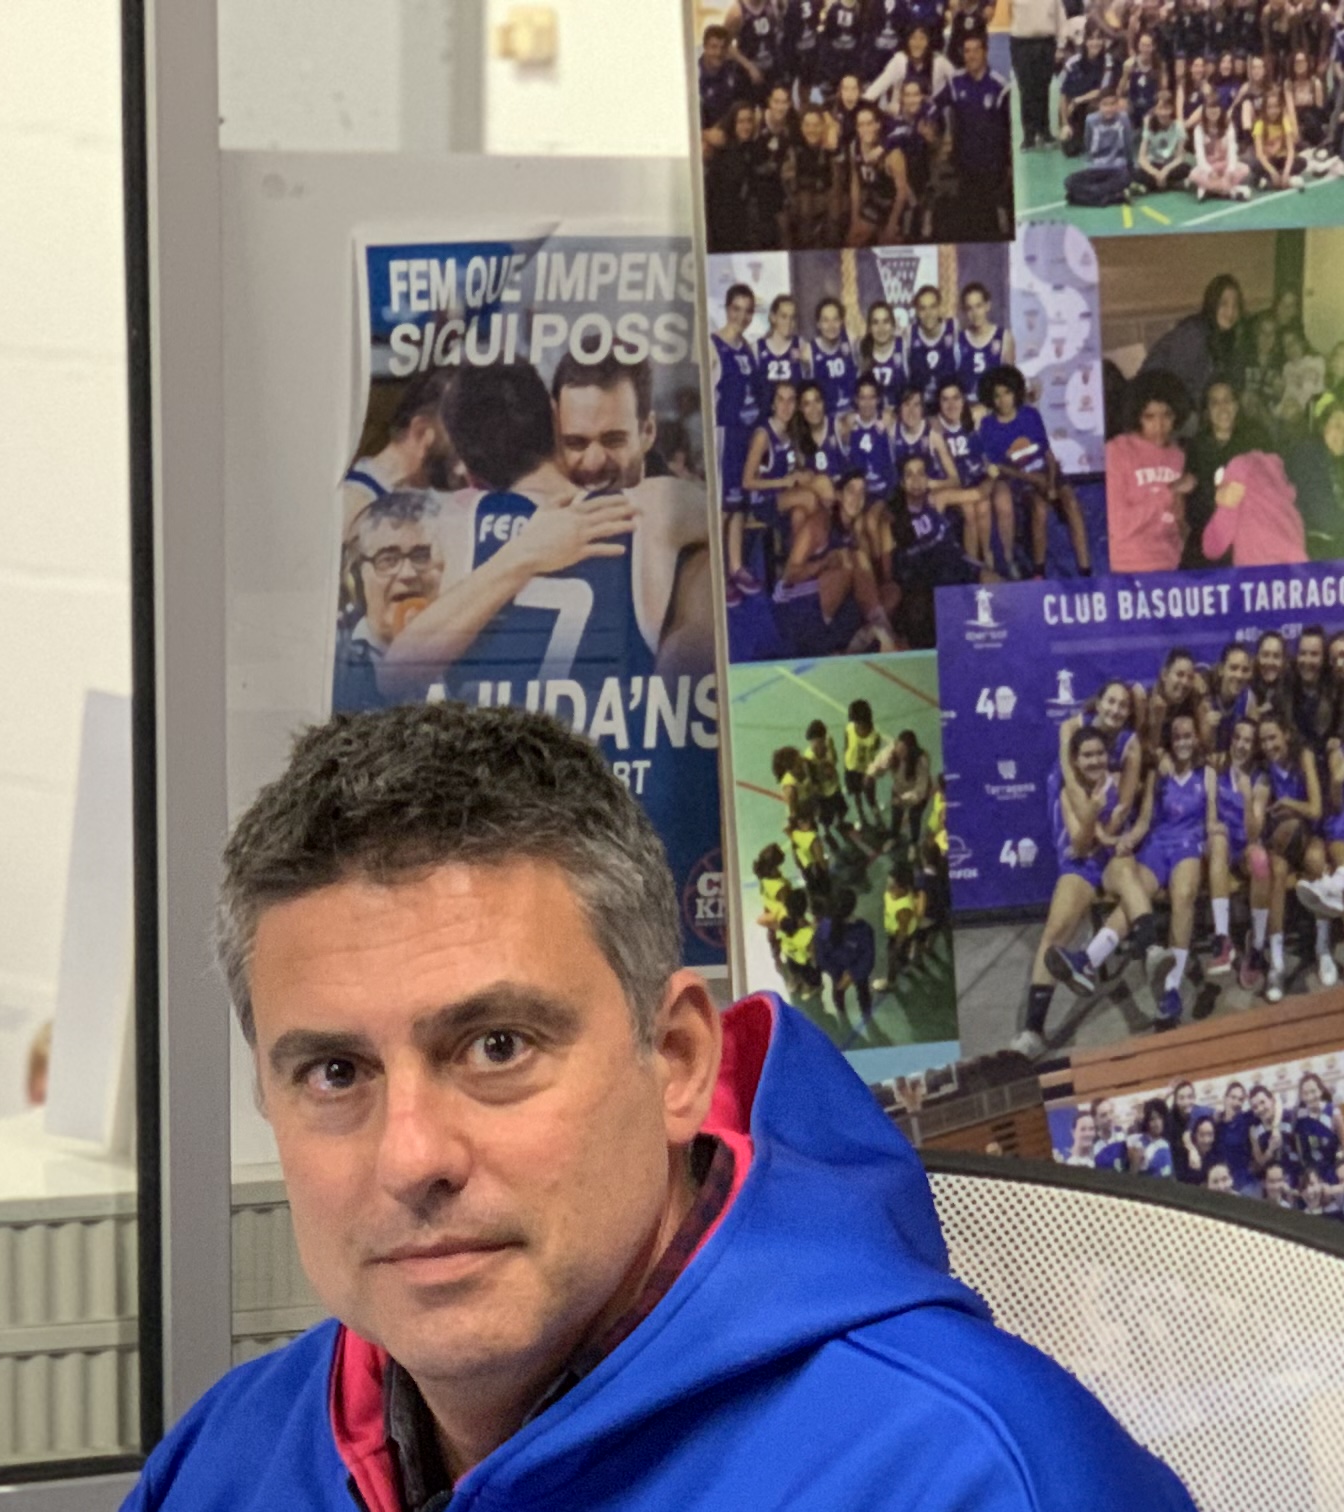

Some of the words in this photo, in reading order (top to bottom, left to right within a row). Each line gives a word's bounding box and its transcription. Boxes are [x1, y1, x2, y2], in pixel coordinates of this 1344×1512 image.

[388, 257, 456, 313] FEM
[465, 253, 526, 308] QUE
[388, 312, 517, 377] SIGUI
[767, 360, 792, 381] 23
[825, 358, 845, 377] 10
[926, 351, 940, 371] 9
[972, 350, 986, 372] 5
[859, 432, 872, 453] 4
[1043, 591, 1107, 625] CLUB
[1117, 580, 1231, 620] BÀSQUET
[514, 577, 593, 684] 7
